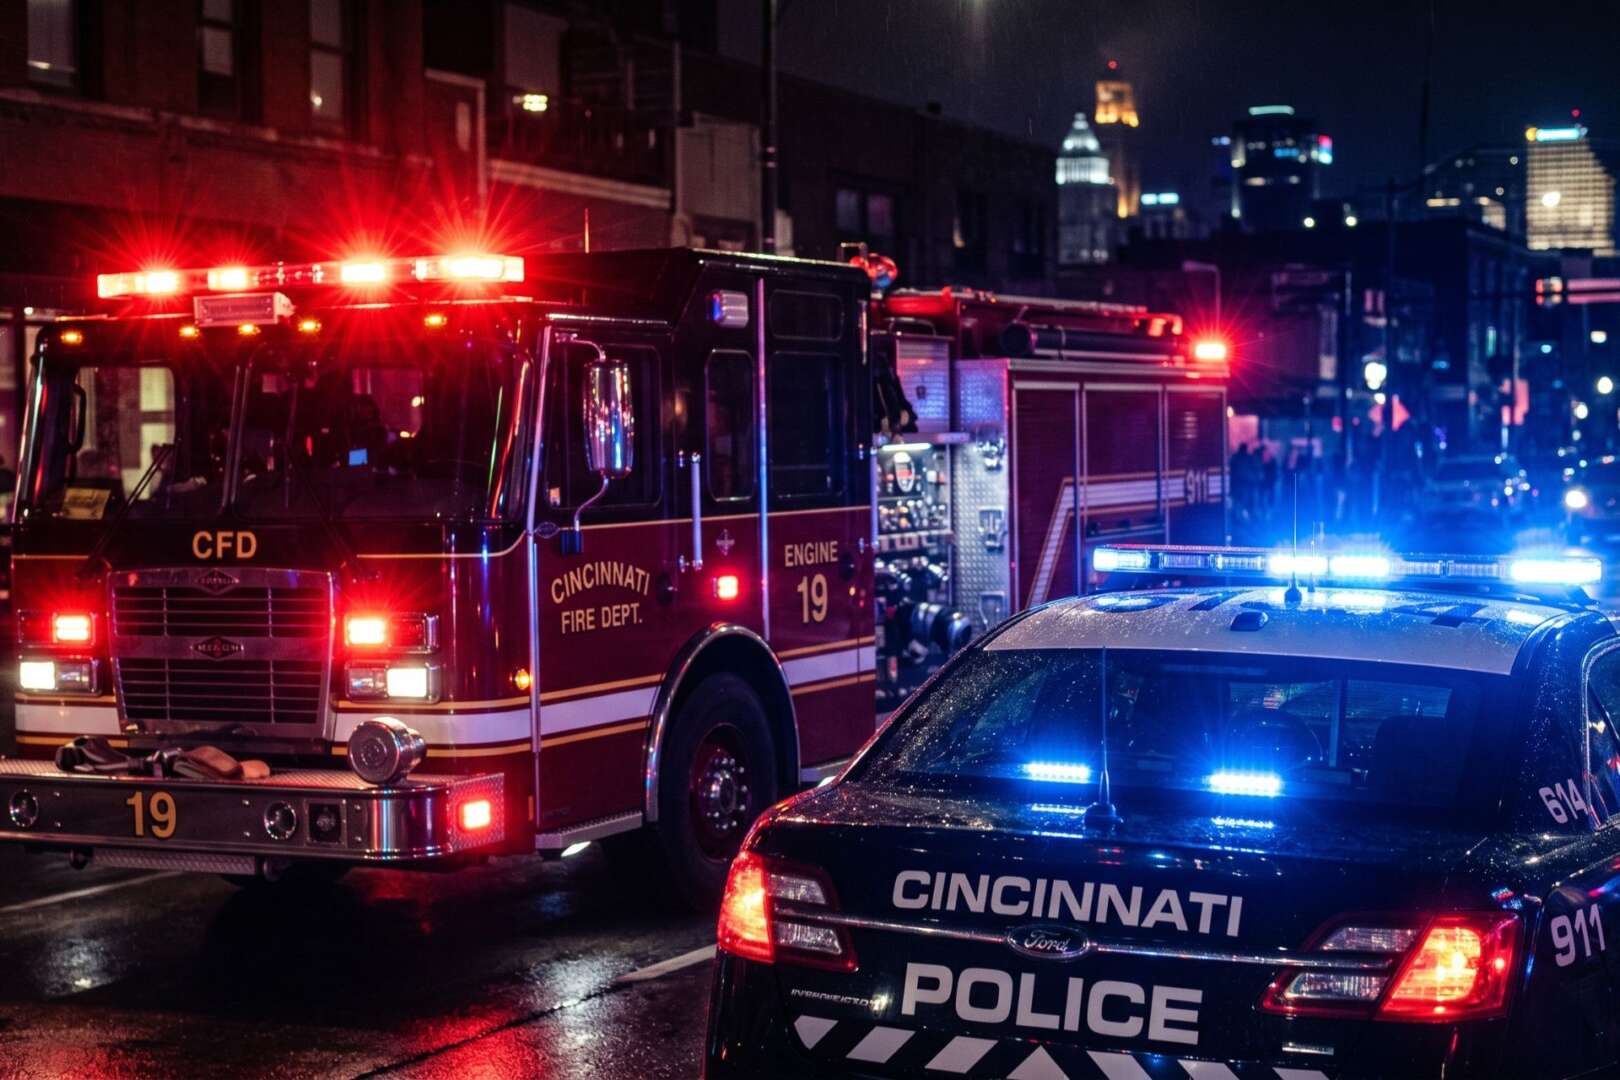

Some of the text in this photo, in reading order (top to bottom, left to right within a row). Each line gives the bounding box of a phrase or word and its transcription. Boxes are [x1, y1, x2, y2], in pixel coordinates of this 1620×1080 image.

[1187, 471, 1207, 504] 911
[192, 531, 258, 559] CFD
[784, 540, 839, 567] ENGINE
[551, 561, 650, 605] CINCINNATI
[797, 574, 829, 623] 19
[560, 603, 643, 634] FIRE DEPT.
[126, 791, 177, 838] 19
[1538, 778, 1589, 825] 614
[891, 870, 1243, 938] CINCINNATI
[1024, 929, 1071, 952] Ford
[1551, 903, 1606, 967] 911
[901, 962, 1203, 1045] POLICE
